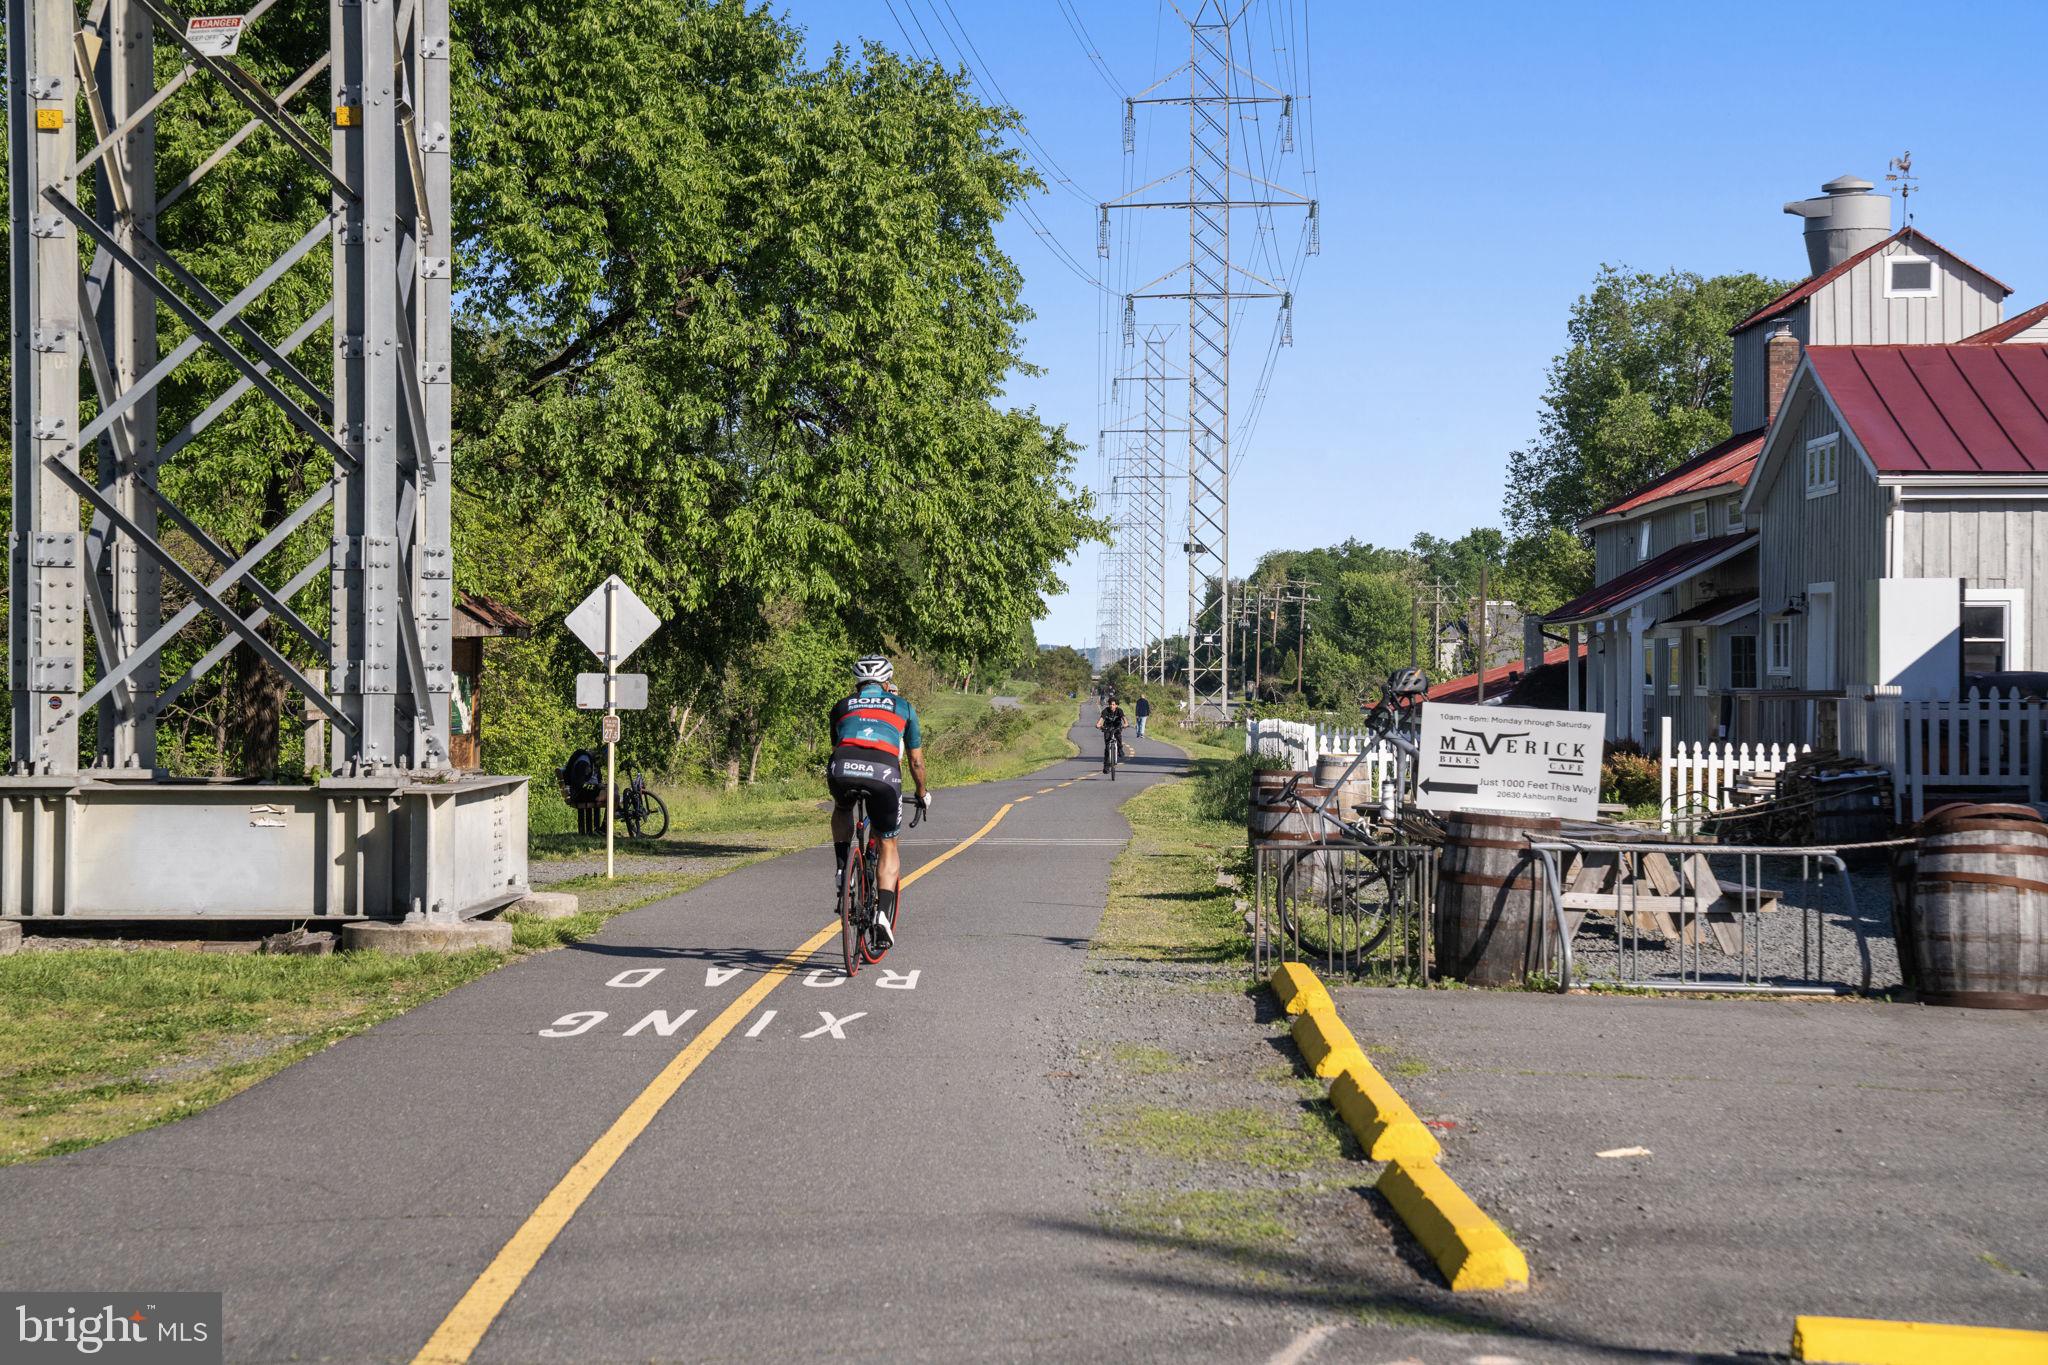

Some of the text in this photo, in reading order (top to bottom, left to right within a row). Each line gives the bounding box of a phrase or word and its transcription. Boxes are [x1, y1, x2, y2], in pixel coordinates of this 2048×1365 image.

[200, 18, 238, 28] DANGER
[848, 697, 894, 706] BORA
[1440, 713, 1462, 721] 10am
[1491, 716, 1522, 726] Monday
[1524, 719, 1554, 728] through
[1556, 720, 1592, 730] Saturday
[1440, 728, 1586, 758] MAVERICK
[1439, 755, 1480, 765] BIKES
[843, 762, 875, 772] BORA
[1549, 762, 1584, 772] CAFE
[1479, 777, 1597, 796] Just 1000 Feet This Way!
[1496, 790, 1578, 803] 20630 Ashburn Road
[605, 967, 922, 990] ROAD
[538, 1008, 868, 1039] XING
